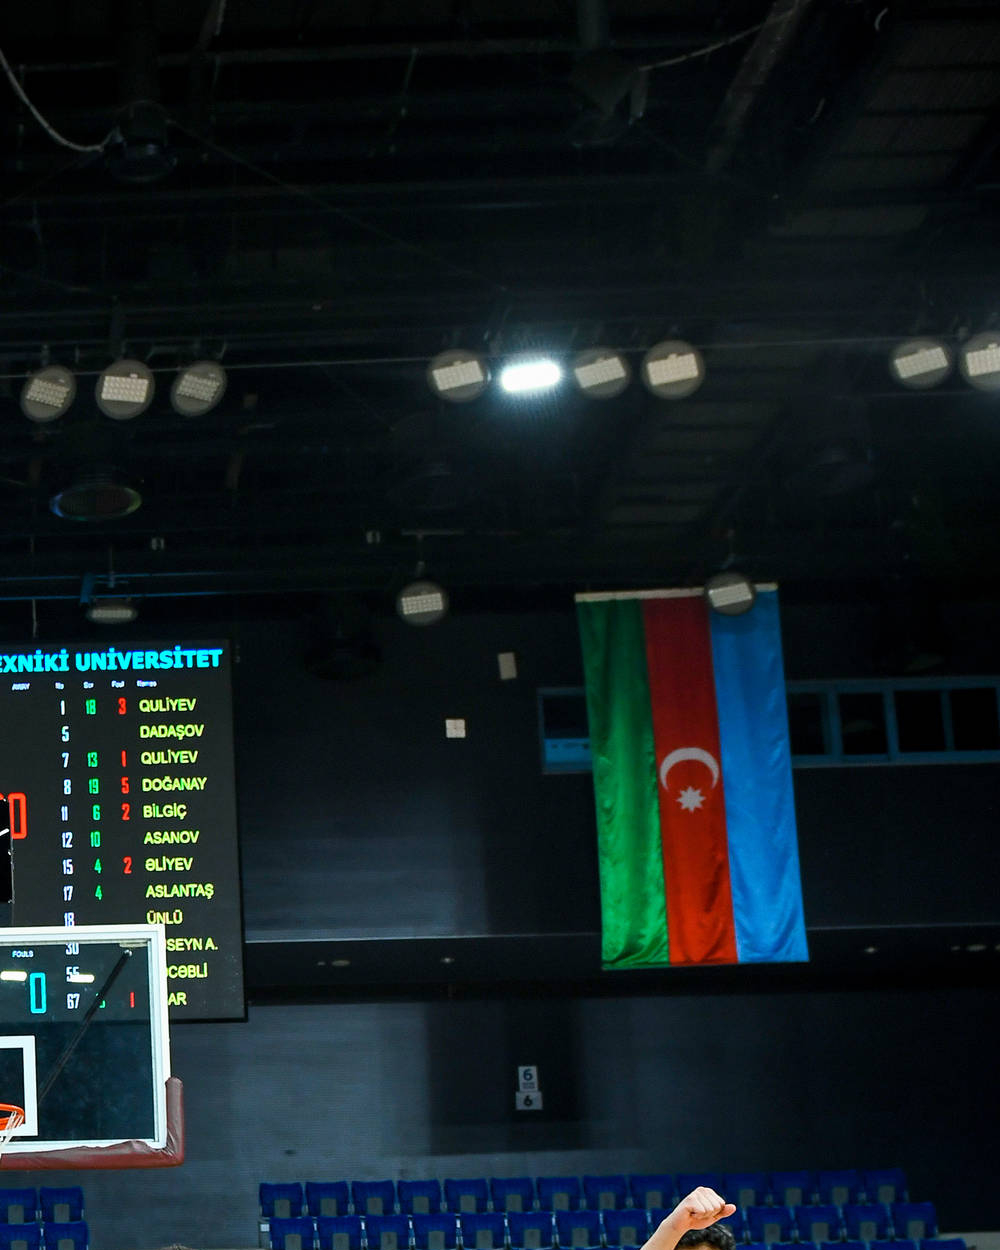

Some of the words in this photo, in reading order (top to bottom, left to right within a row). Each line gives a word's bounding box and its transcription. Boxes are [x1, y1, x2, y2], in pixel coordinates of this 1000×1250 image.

[76, 645, 223, 671] UNİVERSİTET
[61, 700, 65, 715] 1
[86, 699, 96, 714] 18
[118, 698, 126, 714] 3
[139, 697, 196, 712] QULİYEV
[62, 726, 69, 742] 5
[140, 724, 204, 740] DADAŞOV
[62, 752, 69, 767] 7
[88, 752, 98, 767] 13
[122, 751, 126, 767] 1
[141, 749, 198, 764] QULİYEV
[64, 779, 71, 794] 8
[89, 778, 99, 794] 19
[121, 777, 129, 794] 5
[142, 776, 207, 791] DOĞANAY
[61, 806, 68, 821] 11
[93, 805, 100, 820] 6
[122, 803, 130, 820] 2
[143, 803, 187, 819] BİLGİÇ
[62, 832, 72, 848] 12
[90, 831, 100, 847] 10
[144, 831, 199, 844] ASANOV
[63, 859, 73, 874] 15
[94, 859, 101, 873] 4
[123, 856, 132, 874] 2
[145, 856, 193, 871] ƏLİYEV
[63, 886, 73, 901] 17
[95, 885, 102, 900] 4
[146, 883, 214, 899] ASLANTAŞ
[146, 909, 183, 924] ÜNLÜ
[166, 938, 204, 952] SEYN
[205, 938, 218, 950] A.
[164, 963, 208, 979] CƏBLİ
[30, 972, 46, 1014] 0
[67, 993, 80, 1009] 67
[167, 993, 188, 1006] AR
[523, 1069, 533, 1081] 6
